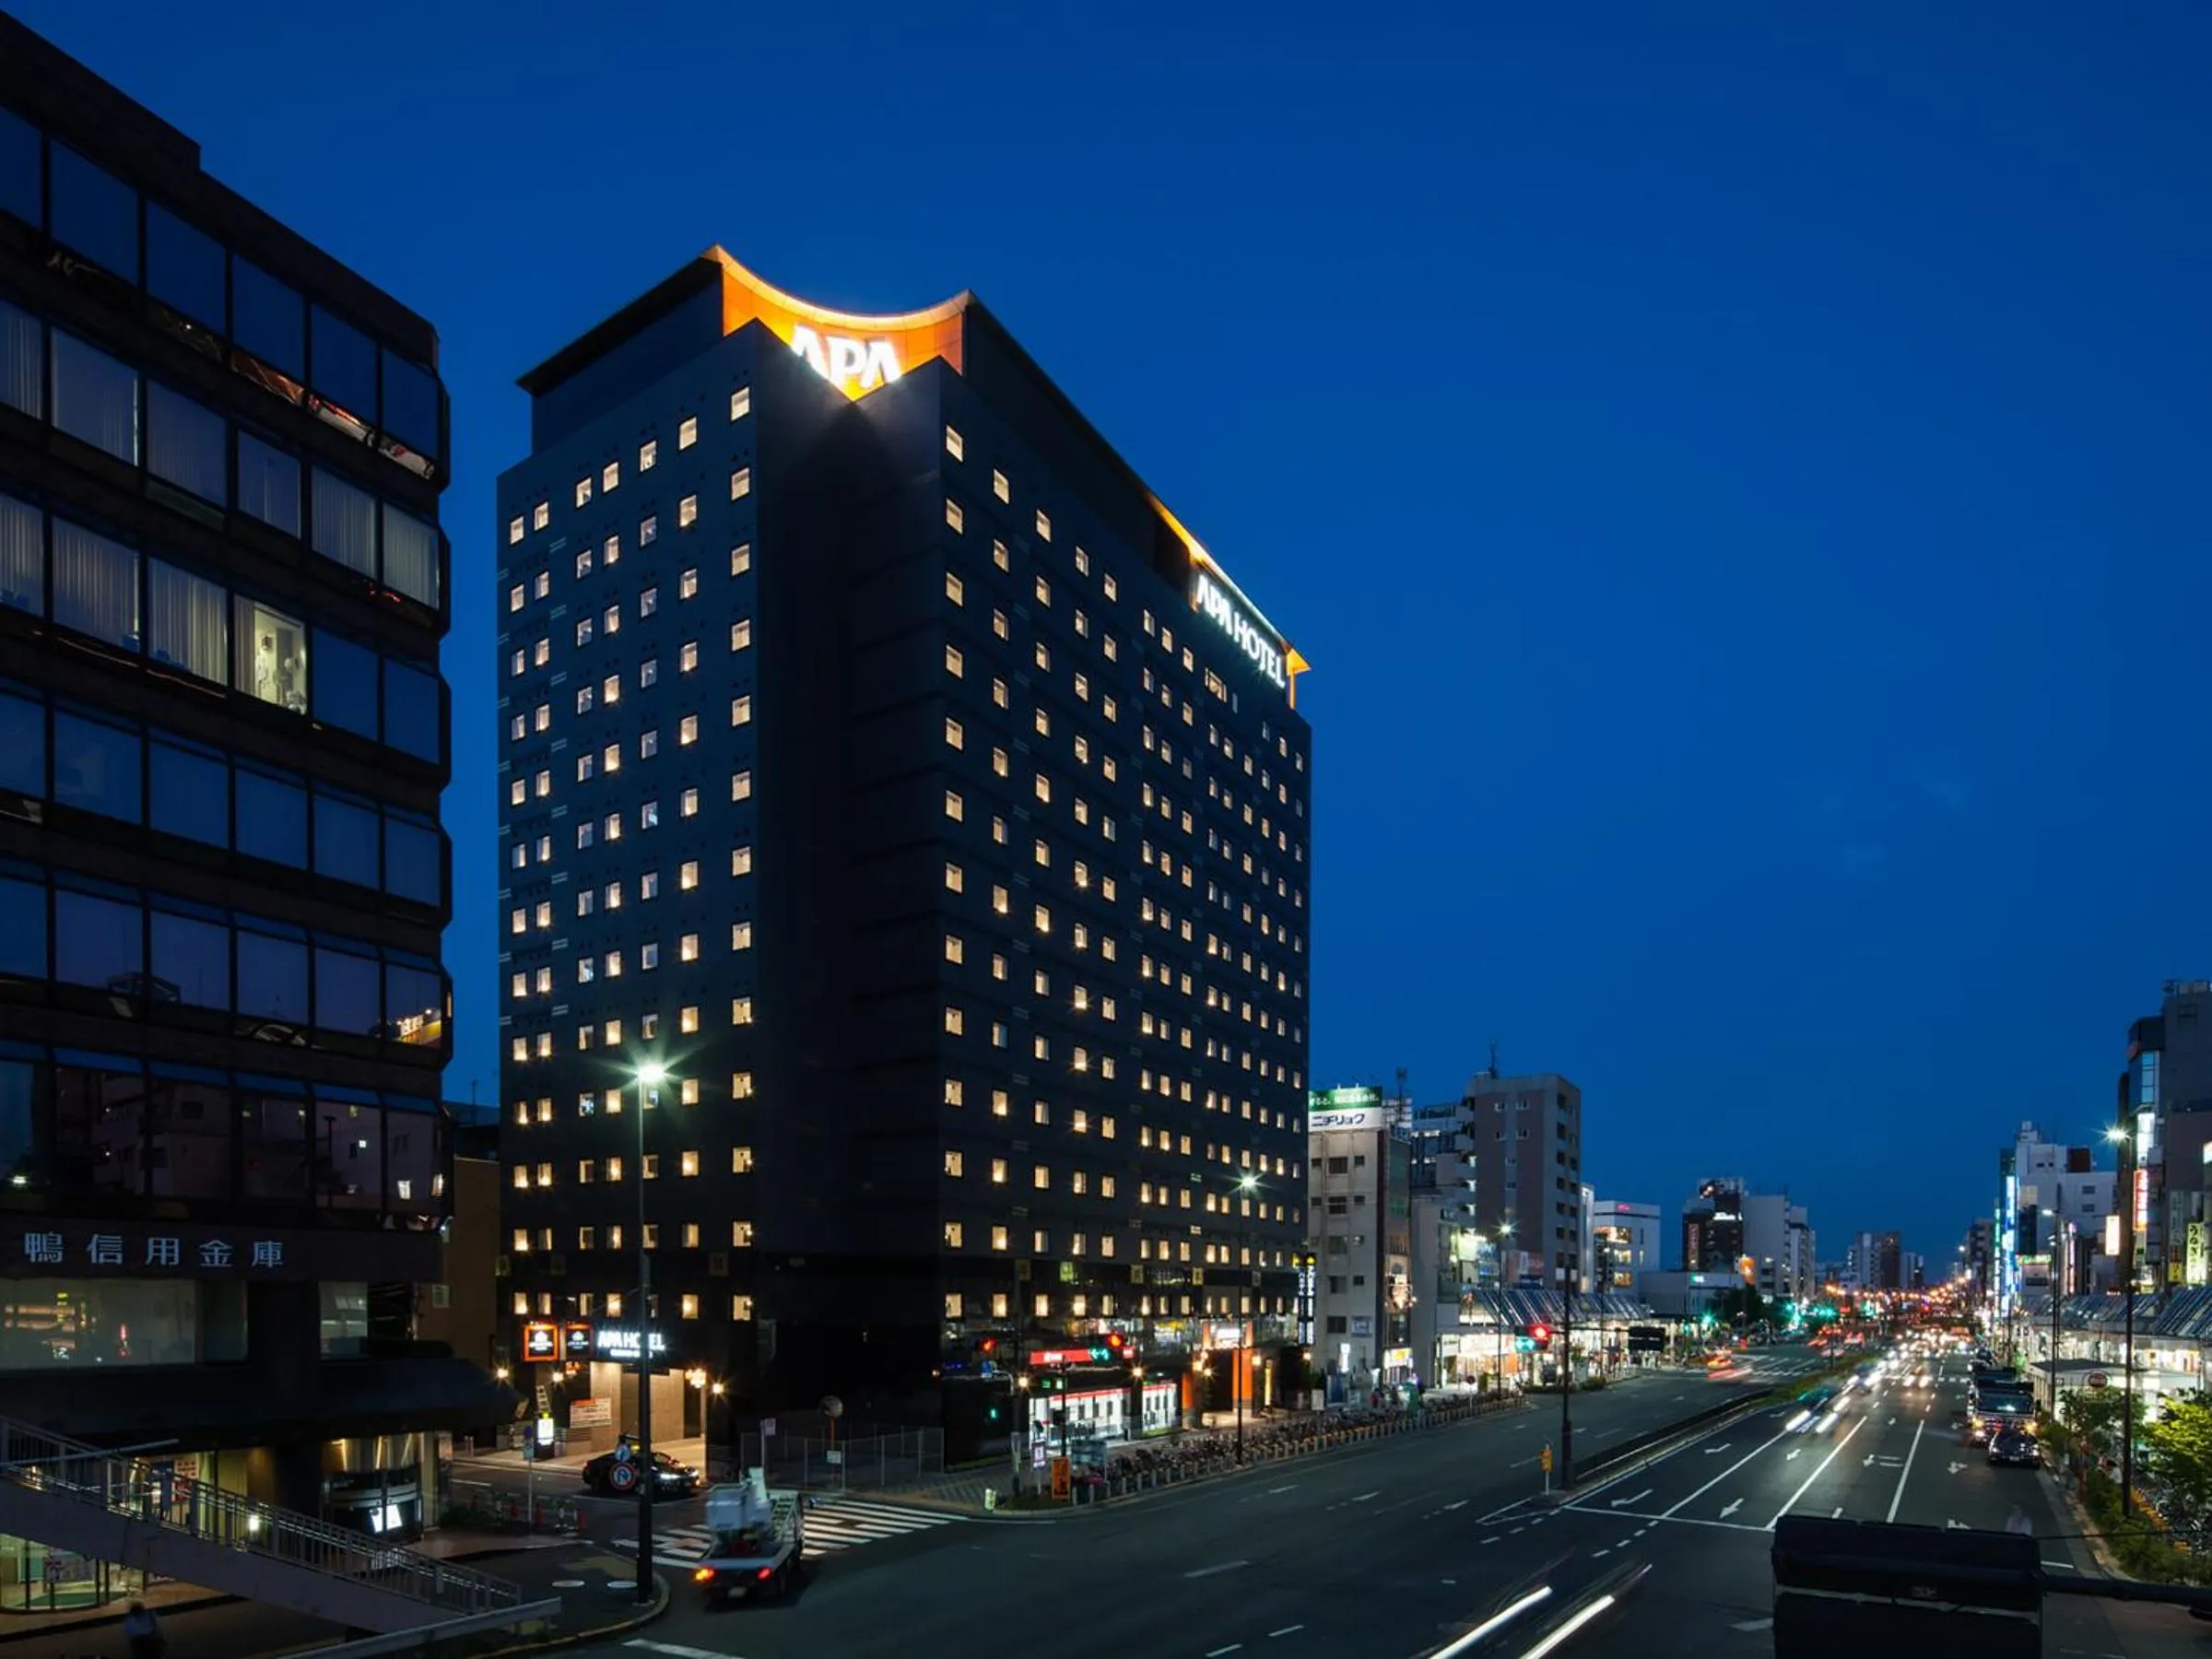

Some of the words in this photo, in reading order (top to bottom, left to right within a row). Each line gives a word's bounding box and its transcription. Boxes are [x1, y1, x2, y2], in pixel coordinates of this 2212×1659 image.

[792, 324, 903, 388] APA
[1196, 574, 1232, 636] APA
[1234, 611, 1286, 688] HOTEL
[24, 1231, 283, 1268] 鴨信用金庫
[623, 1332, 665, 1350] HOEL
